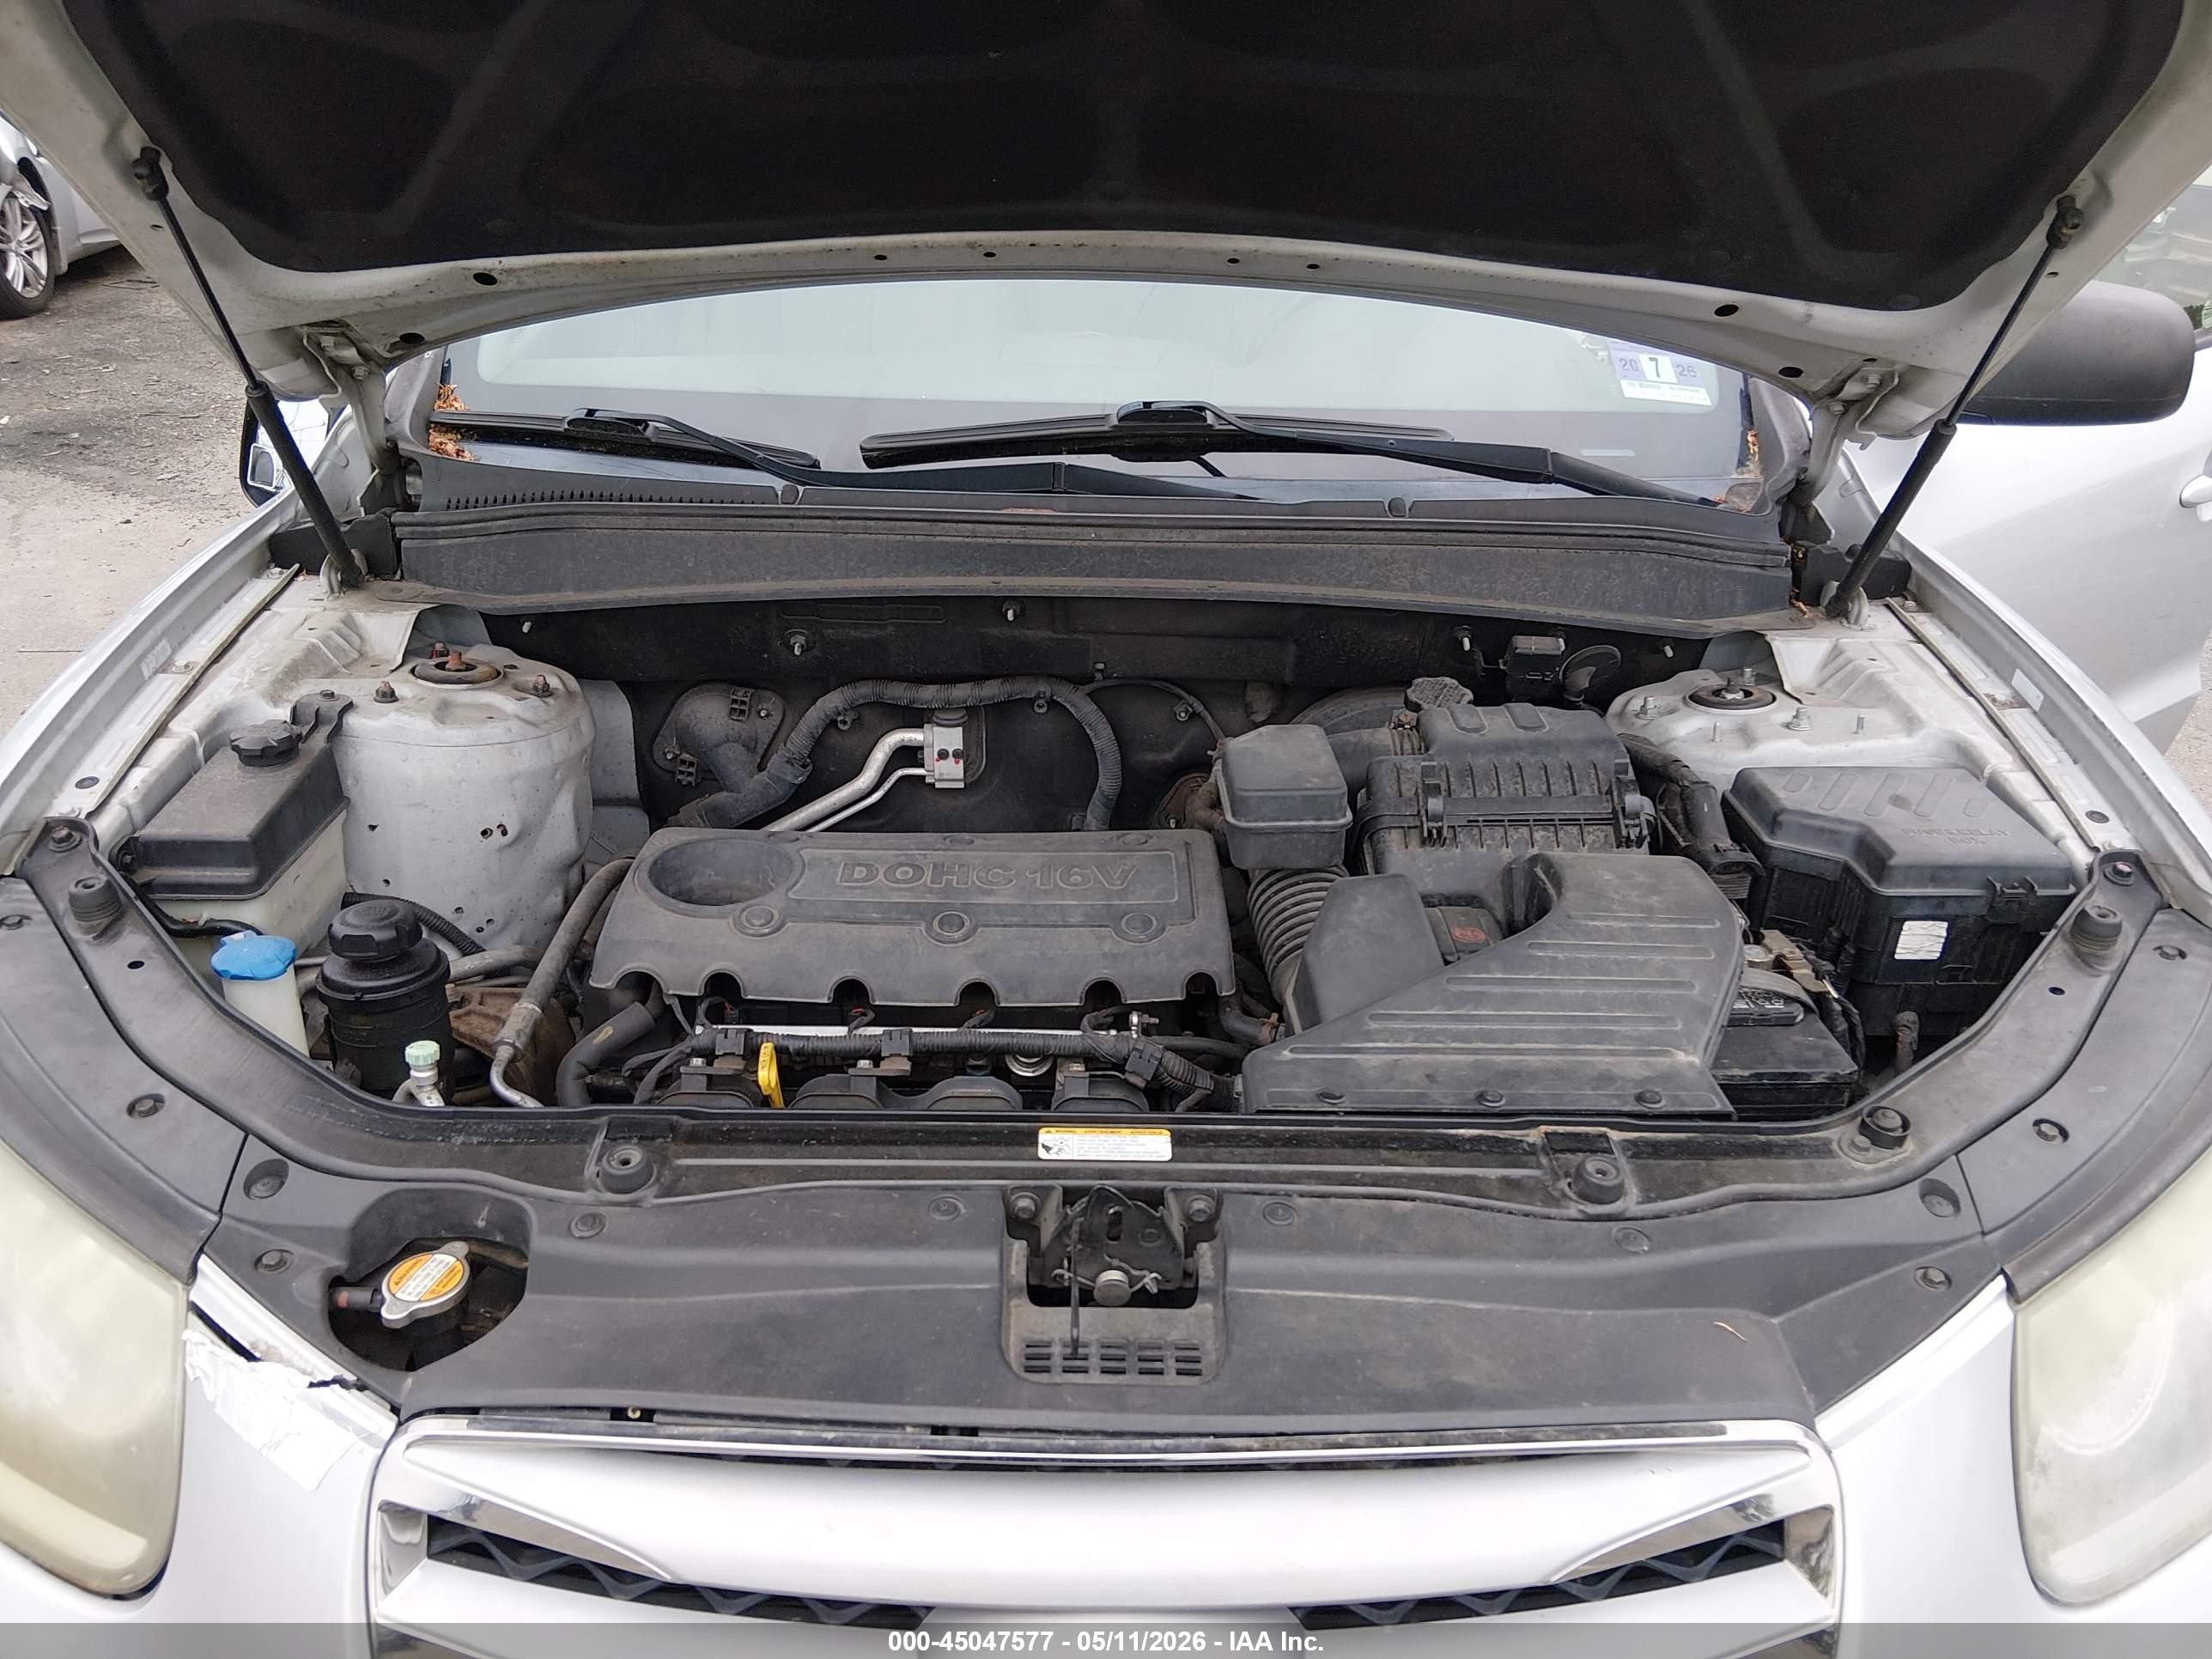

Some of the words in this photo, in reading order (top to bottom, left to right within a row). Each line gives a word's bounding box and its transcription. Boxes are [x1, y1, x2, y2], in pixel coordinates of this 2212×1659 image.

[1619, 357, 1639, 372] 20
[1648, 356, 1661, 379] 7
[1675, 364, 1698, 378] 26
[838, 861, 1017, 890] DOHC
[1026, 862, 1138, 890] 16V
